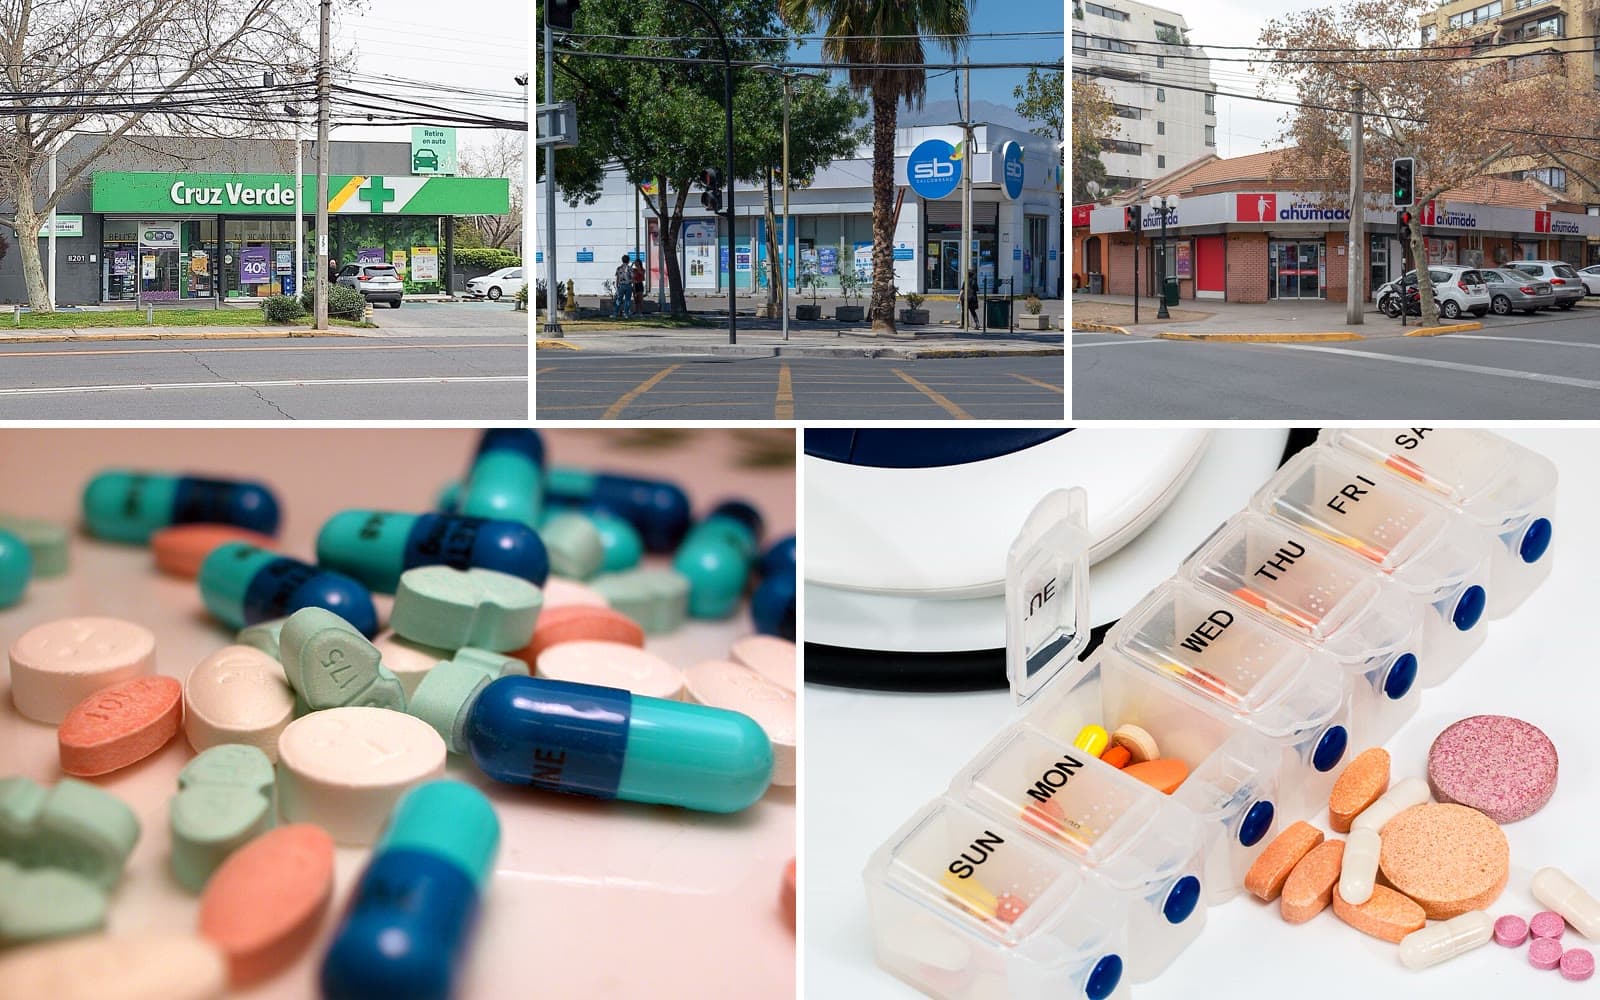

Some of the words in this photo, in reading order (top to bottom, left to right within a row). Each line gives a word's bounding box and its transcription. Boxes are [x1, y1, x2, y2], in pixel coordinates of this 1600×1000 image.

[424, 129, 444, 137] Retiro
[914, 158, 954, 178] sb
[1006, 159, 1022, 177] sb
[170, 181, 223, 205] Cruz
[226, 182, 295, 206] Verde
[1142, 213, 1179, 228] ahumda
[1327, 475, 1376, 514] FRI
[1254, 540, 1306, 581] THU
[1180, 609, 1234, 653] WED
[320, 648, 359, 690] 175
[1026, 754, 1084, 804] MON
[948, 830, 1005, 879] SUN
